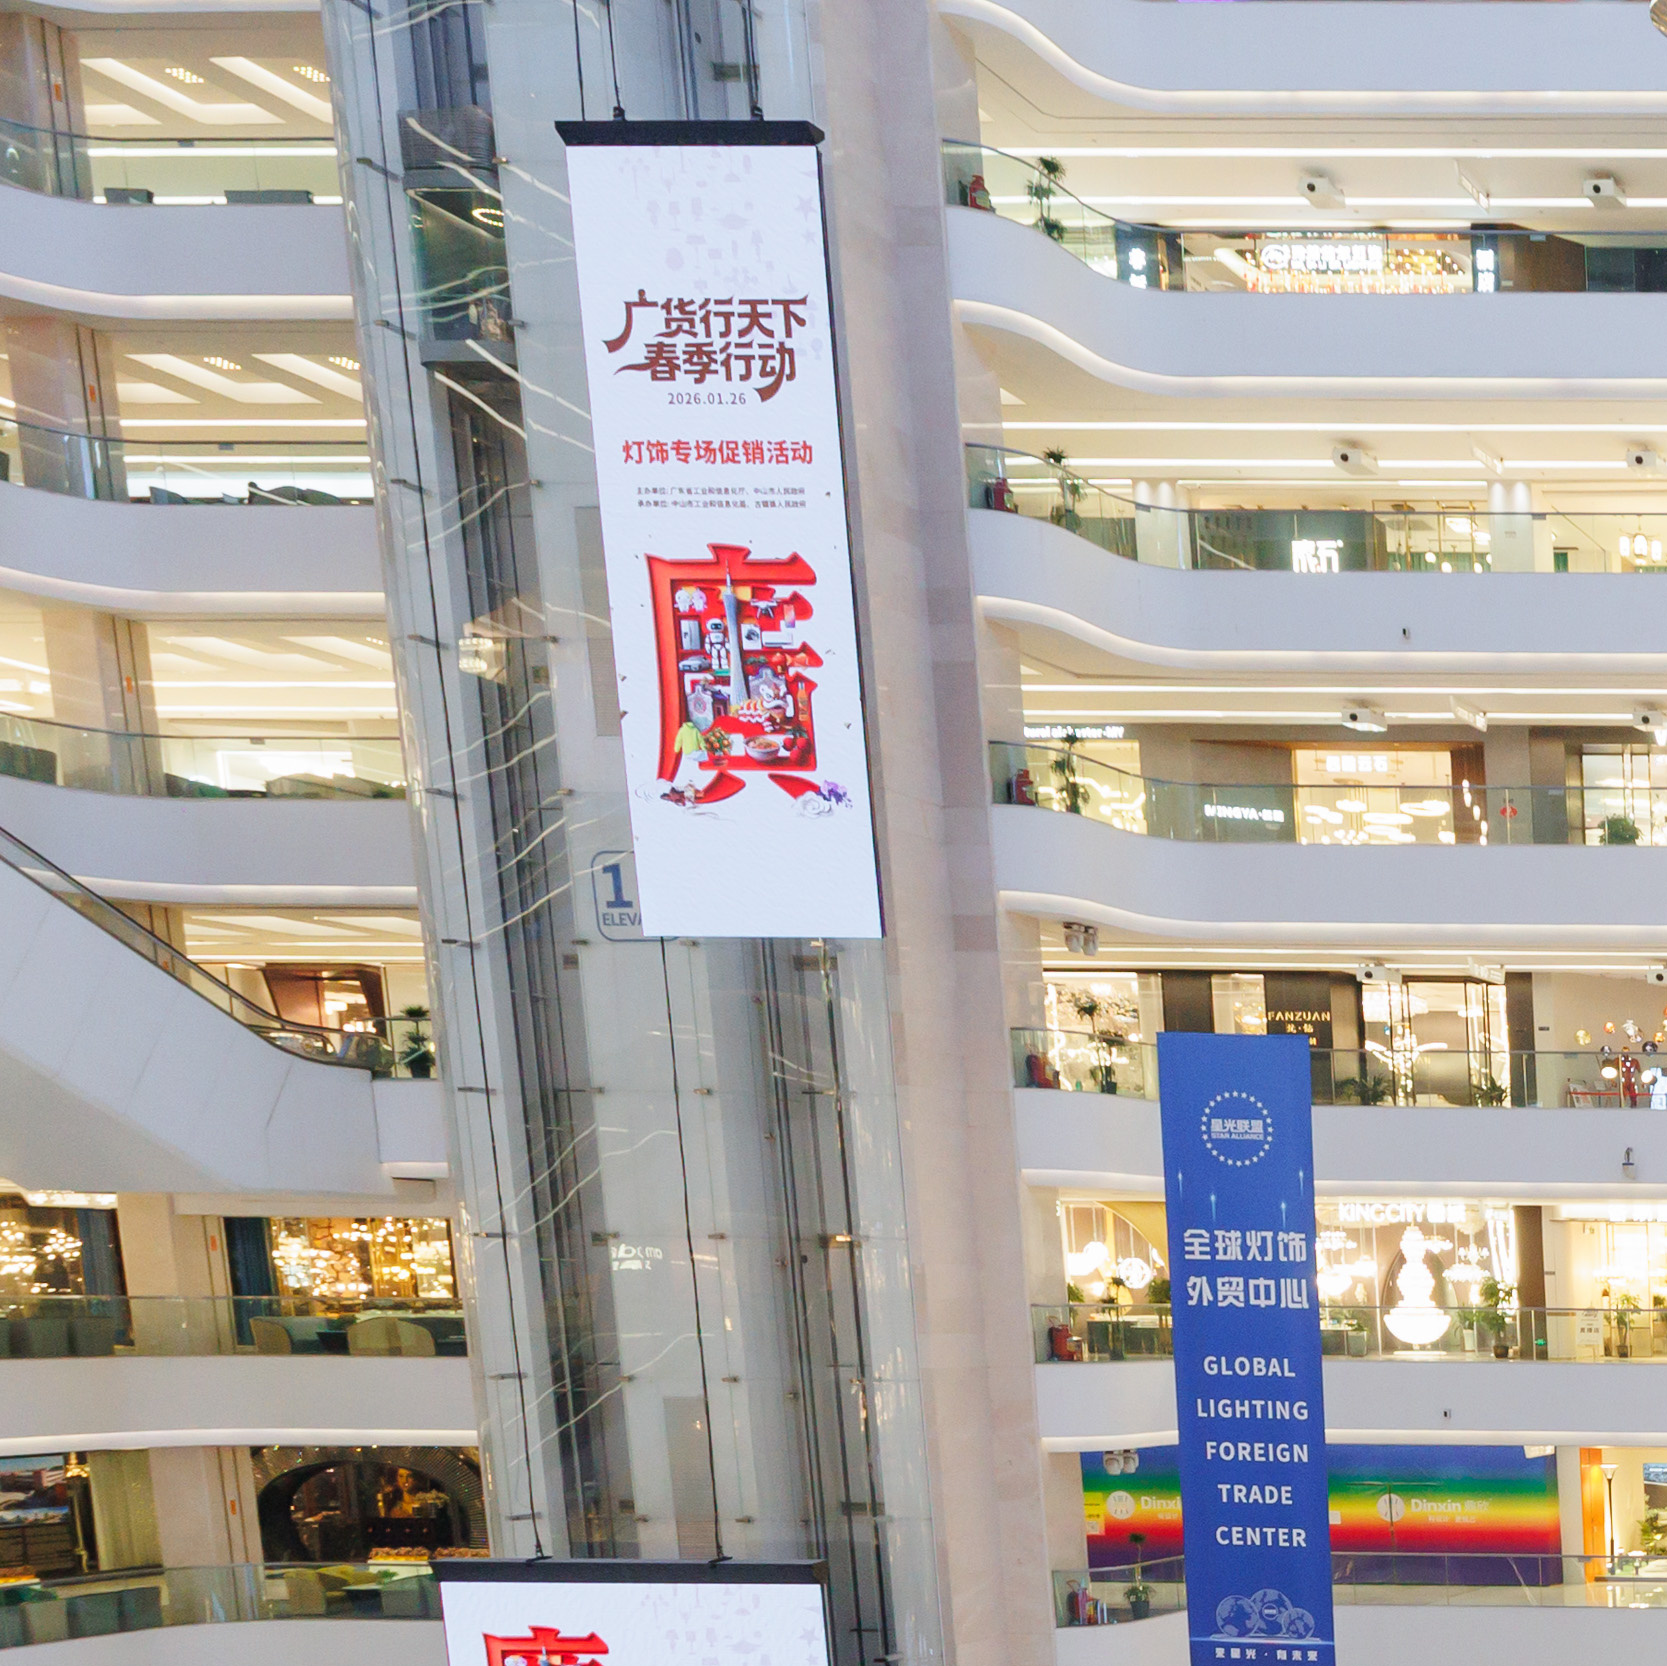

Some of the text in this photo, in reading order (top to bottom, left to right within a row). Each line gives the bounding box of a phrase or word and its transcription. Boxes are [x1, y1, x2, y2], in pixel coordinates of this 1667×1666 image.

[602, 289, 809, 353] 广货行天下
[614, 340, 797, 402] 春季行动
[668, 393, 746, 405] 2026.01.26
[622, 440, 813, 464] 灯饰专场促销活动
[1268, 1011, 1331, 1022] FANZUAN
[1211, 1119, 1263, 1133] 星光联盟
[1183, 1229, 1308, 1262] 全球灯饰
[1186, 1275, 1310, 1309] 外贸中心
[1203, 1356, 1297, 1379] GLOBAL
[1196, 1398, 1310, 1420] LIGHTING
[1206, 1441, 1309, 1462] FOREIGN
[1217, 1484, 1293, 1505] TRADE
[1215, 1526, 1307, 1548] CENTER
